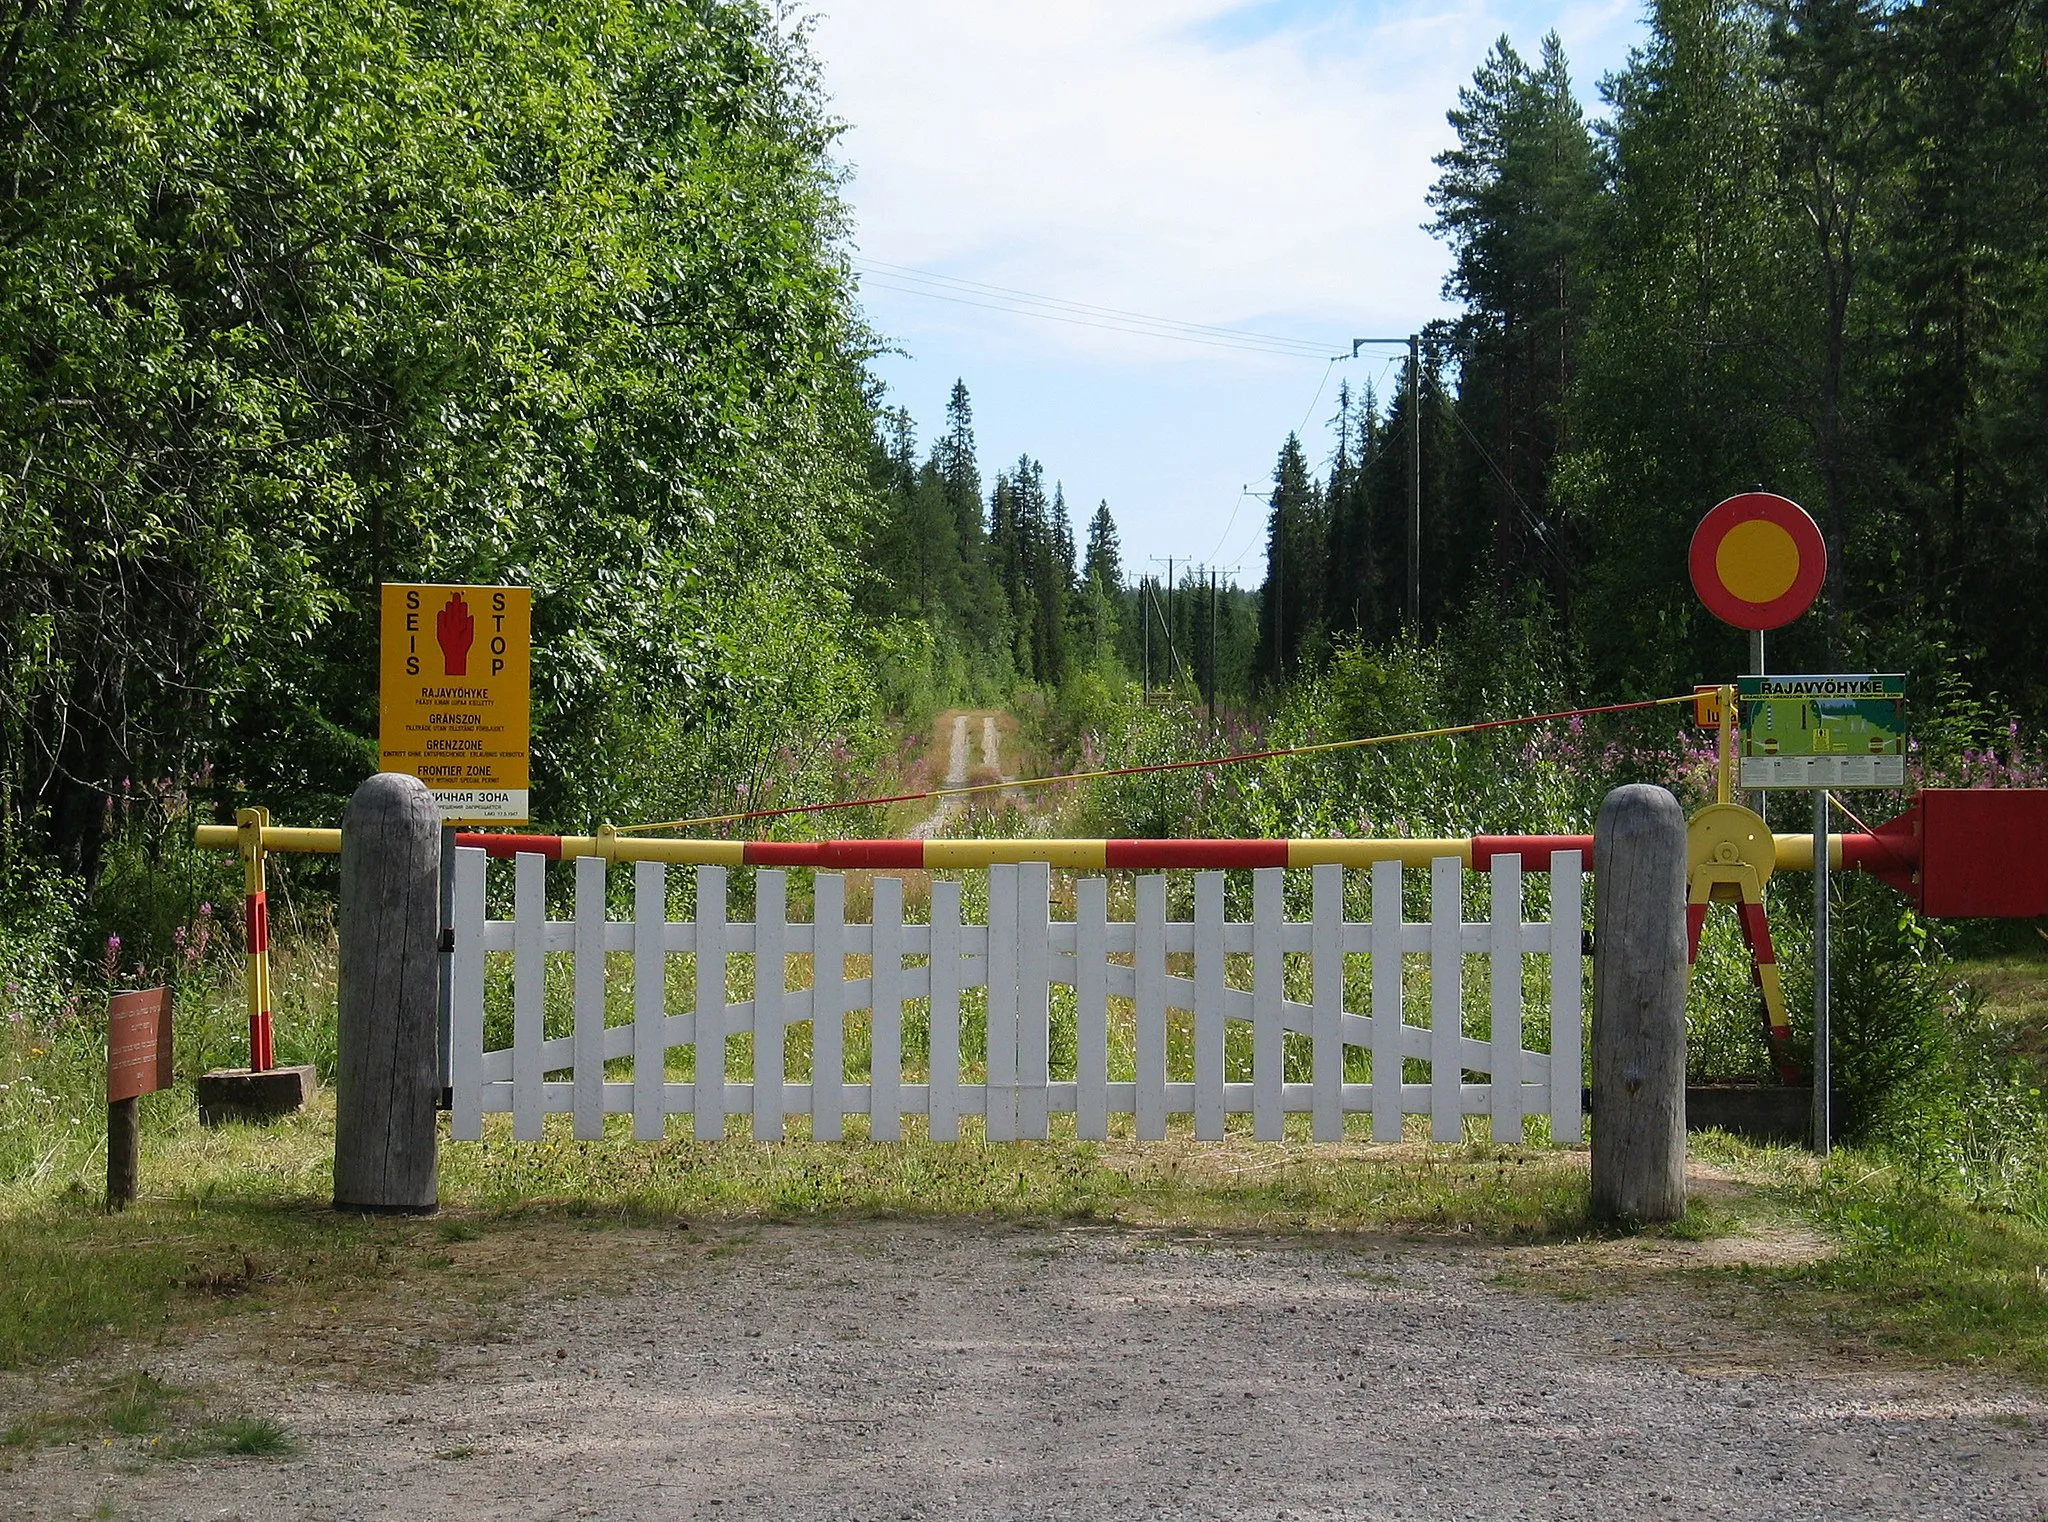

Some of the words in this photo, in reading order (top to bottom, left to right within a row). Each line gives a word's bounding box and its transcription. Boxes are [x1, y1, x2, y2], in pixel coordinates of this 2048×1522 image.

[406, 591, 420, 675] SEIS
[490, 592, 506, 676] STOP
[1761, 678, 1883, 694] RAJAVYÖHYKE
[421, 687, 489, 699] RAJAVYÖHYKE
[429, 713, 481, 724] GRÄNSZON
[1707, 708, 1737, 722] lua
[426, 740, 483, 750] GRENZZONE
[417, 765, 462, 776] FRONTIER
[467, 765, 492, 776] ZONE
[432, 792, 473, 802] ИЧНАЯ
[478, 792, 509, 802] ЗОНА
